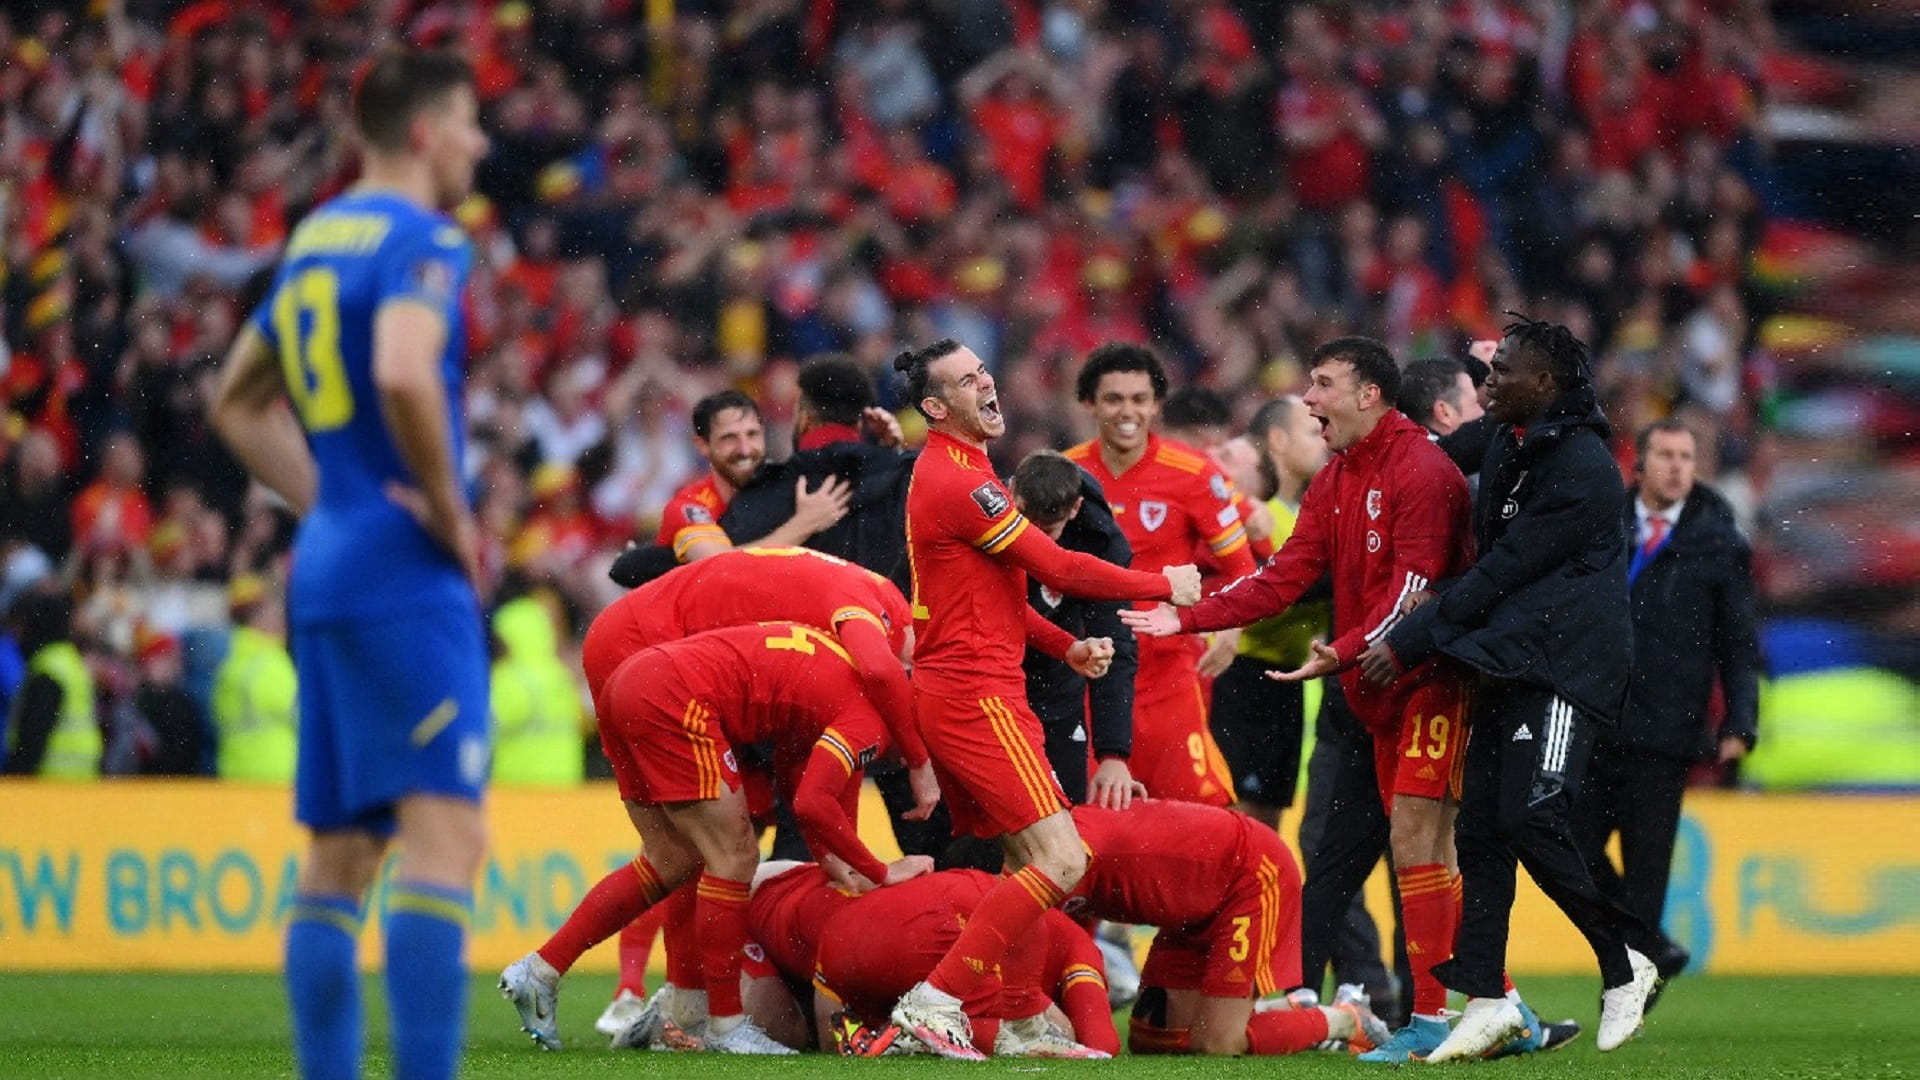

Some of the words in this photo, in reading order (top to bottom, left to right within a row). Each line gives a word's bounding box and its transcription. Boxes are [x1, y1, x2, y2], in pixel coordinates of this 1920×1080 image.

[1187, 732, 1206, 777] 9
[1405, 714, 1450, 760] 19
[0, 848, 80, 934] W
[105, 849, 586, 936] BROND
[1229, 916, 1251, 962] 3
